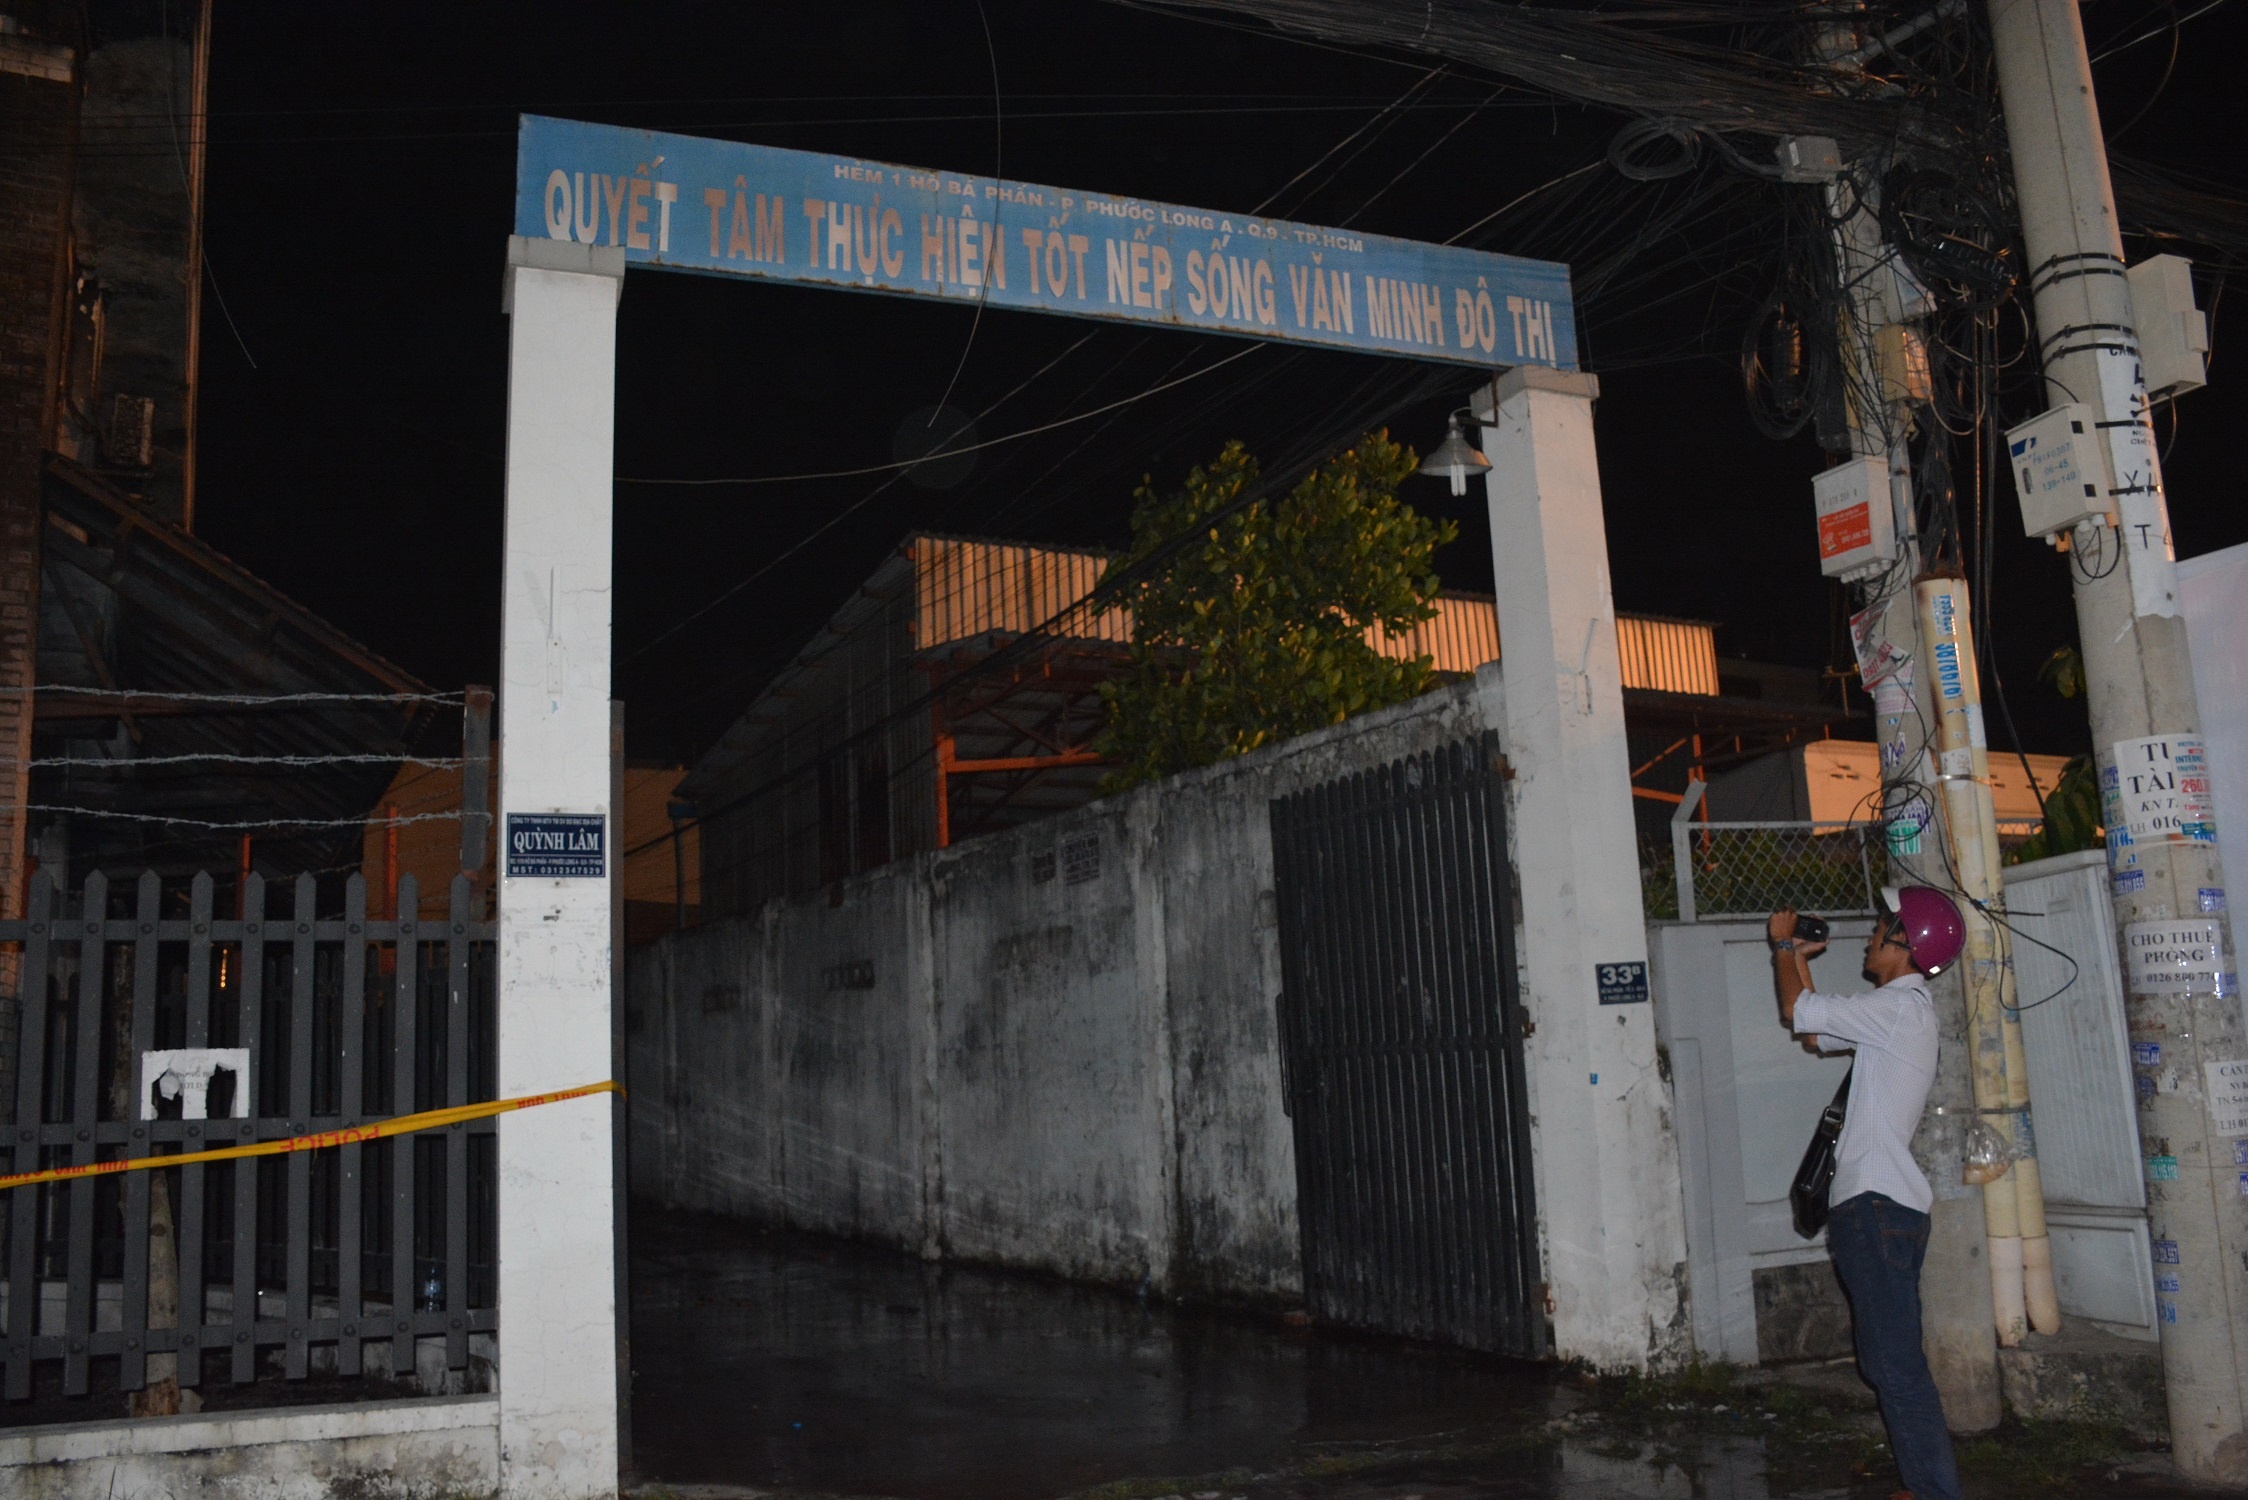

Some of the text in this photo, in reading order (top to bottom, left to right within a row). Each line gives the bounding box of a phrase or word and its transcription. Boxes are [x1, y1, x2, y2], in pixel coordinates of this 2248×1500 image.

[1086, 199, 1155, 222] PHƯỚC
[1161, 212, 1214, 230] LONG
[545, 155, 1557, 368] QUYẾT TÂM THỰC HIỆN TỐT NẾP SỐNG VĂN MINH ĐÔ THỊ
[513, 827, 599, 853] QUỲNH LÂM
[2131, 933, 2164, 947] CHO
[2144, 947, 2204, 963] PHÒNG
